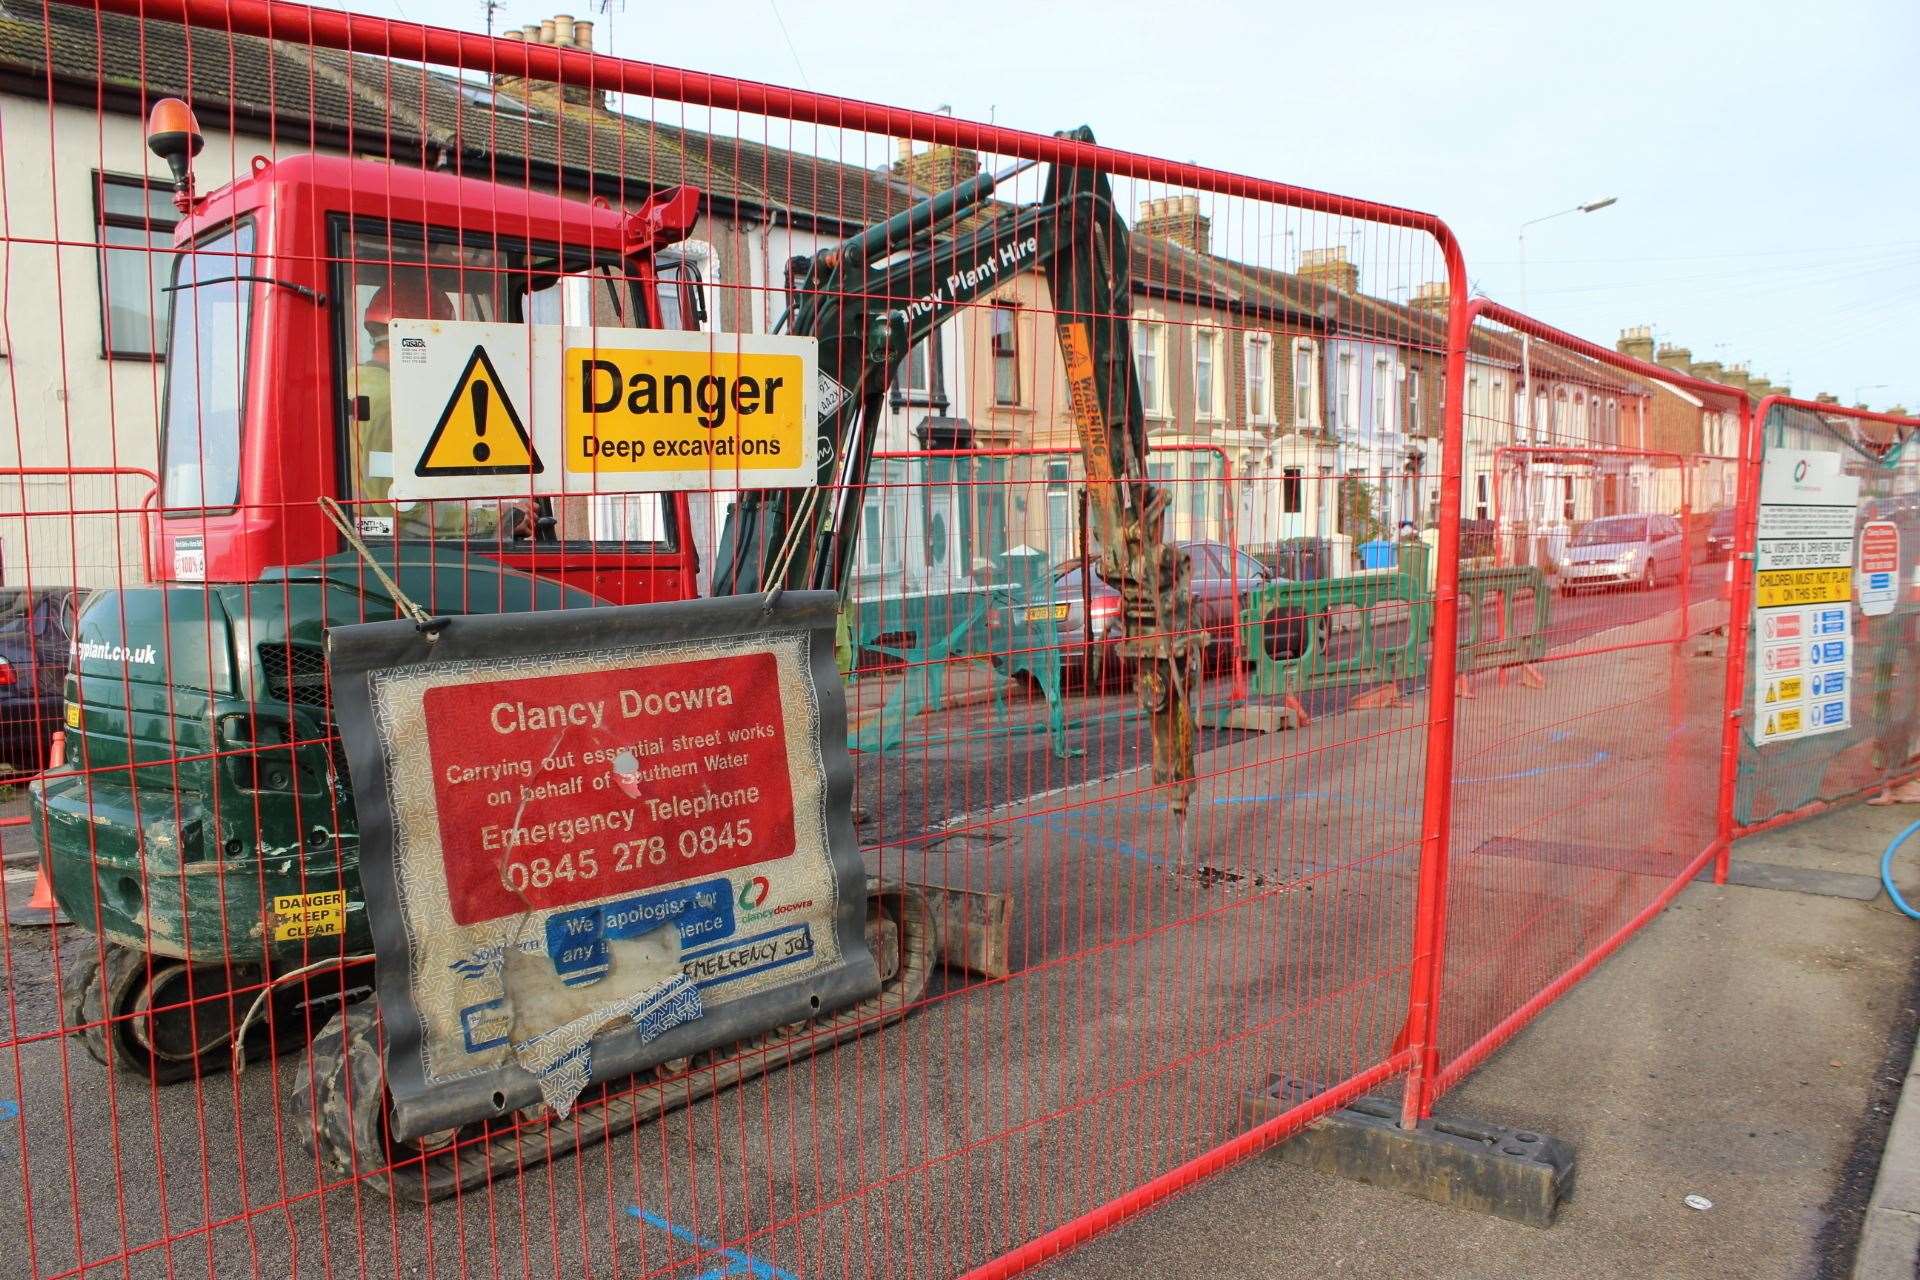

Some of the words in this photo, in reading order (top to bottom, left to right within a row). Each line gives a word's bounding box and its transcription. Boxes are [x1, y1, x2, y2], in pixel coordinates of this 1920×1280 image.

[946, 256, 999, 298] Plant
[1000, 237, 1039, 268] Hire
[582, 359, 784, 429] Danger
[583, 435, 645, 463] Deep
[653, 433, 781, 457] excavations
[490, 701, 605, 735] Clancy
[619, 684, 733, 719] Docwra
[447, 758, 532, 784] Carrying
[543, 752, 575, 771] out
[672, 730, 721, 752] street
[727, 722, 775, 744] works
[487, 789, 511, 806] on
[520, 776, 583, 801] behalf
[592, 771, 611, 790] of
[704, 753, 749, 772] Water
[481, 808, 635, 850] Emergency
[646, 786, 760, 822] Telephone
[502, 849, 599, 892] 0845
[612, 836, 666, 873] 278
[679, 818, 753, 859] 0845
[280, 894, 341, 910] DANGER
[292, 910, 330, 923] KEEP
[566, 917, 594, 936] We
[287, 923, 334, 937] CLEAR
[562, 944, 594, 963] any
